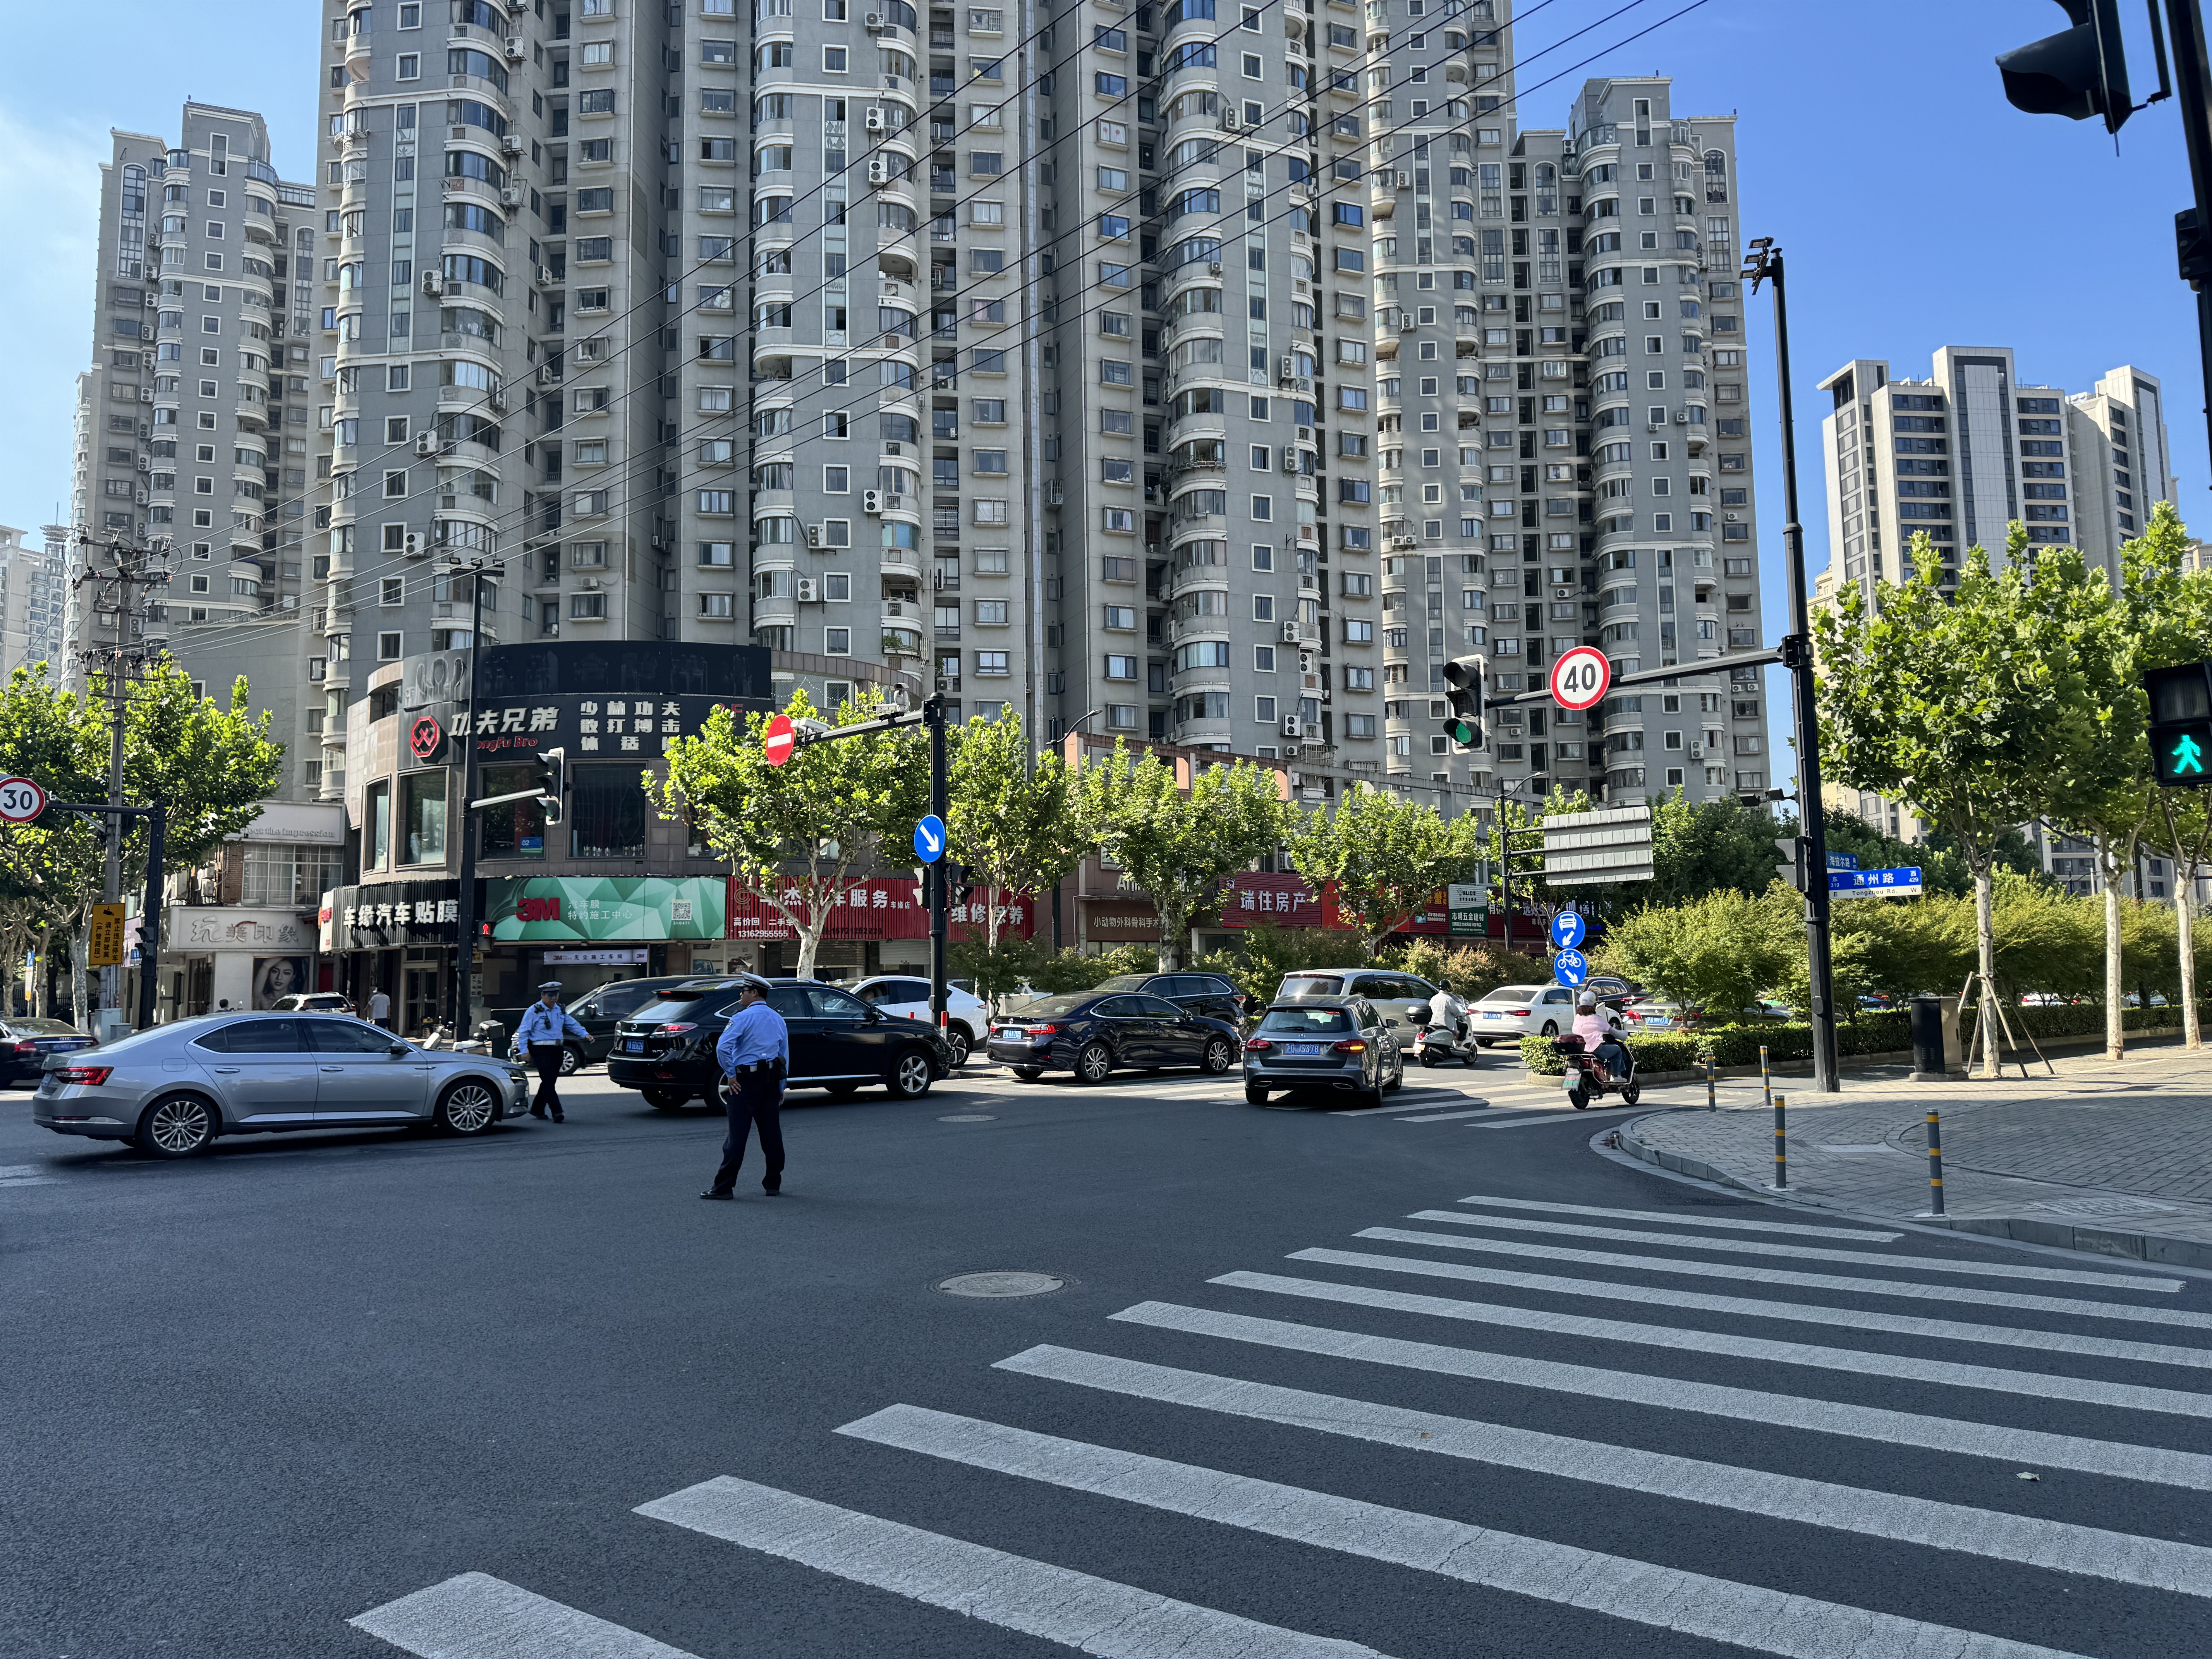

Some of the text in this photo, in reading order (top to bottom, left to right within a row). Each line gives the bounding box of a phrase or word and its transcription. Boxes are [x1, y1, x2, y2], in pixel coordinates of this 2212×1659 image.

[1564, 663, 1596, 692] 40
[580, 701, 680, 716] 少林功夫
[448, 706, 560, 736] 功夫兄弟
[580, 719, 680, 733] 散打搏击
[477, 736, 538, 752] ongFu Bro
[3, 789, 33, 810] 30
[265, 827, 280, 836] the
[282, 828, 335, 838] impression
[1829, 855, 1850, 867] 海拉尔路
[1853, 872, 1894, 886] 通州路
[568, 899, 600, 909] 汽车膜
[890, 901, 910, 909] 车缘店
[1240, 890, 1306, 912] 瑞住房产
[343, 899, 459, 929] 车缘汽车贴膜
[515, 898, 560, 922] 3M
[568, 910, 632, 920] 特约施工中心
[1452, 912, 1484, 921] 志明五金建材
[733, 917, 759, 926] 高价回
[1094, 916, 1174, 929] 小动物外科骨科手术心
[191, 916, 299, 943] 玩美印象
[103, 922, 111, 958] 请立即驶离
